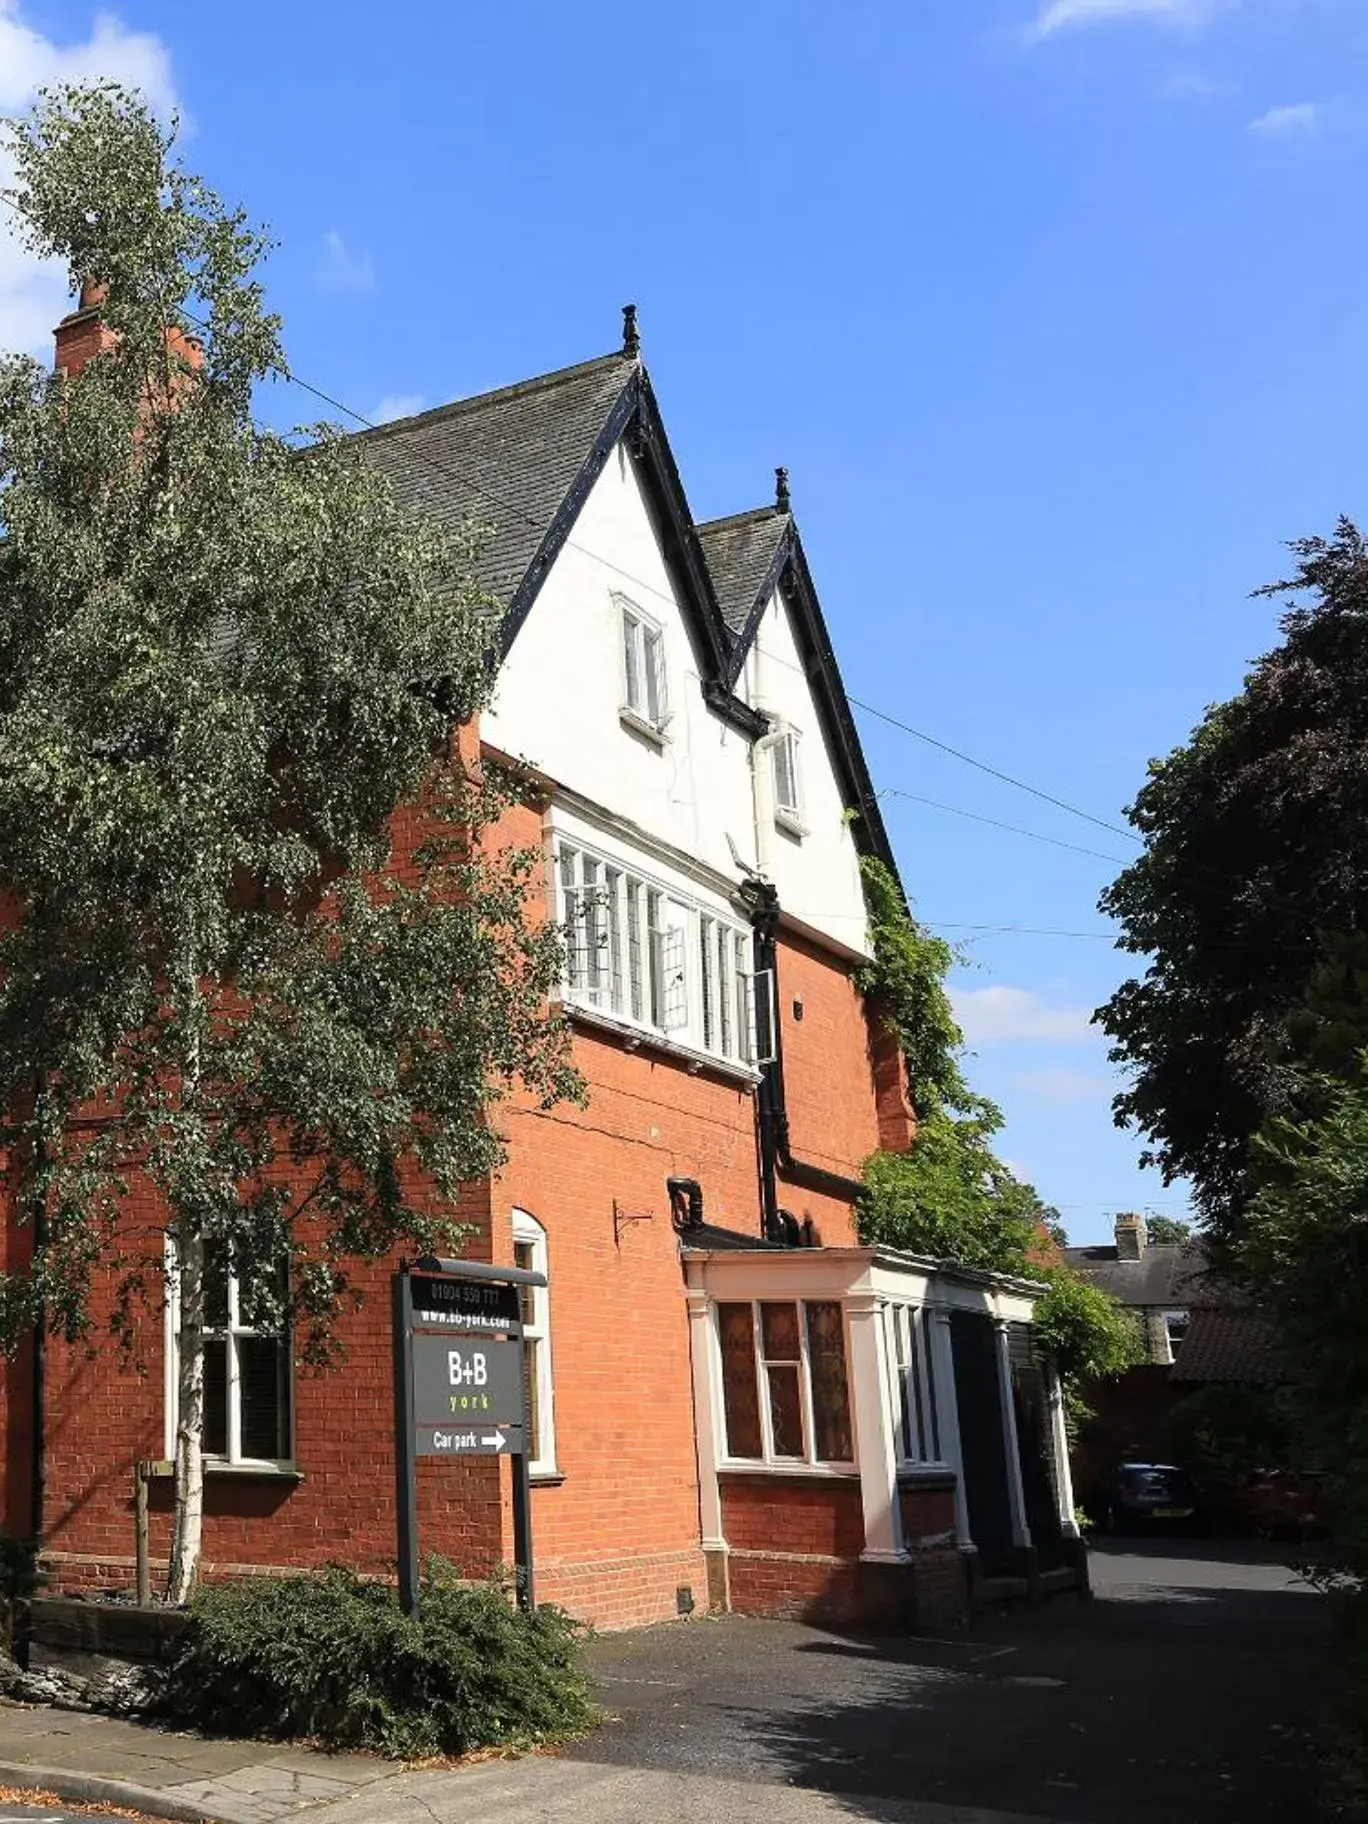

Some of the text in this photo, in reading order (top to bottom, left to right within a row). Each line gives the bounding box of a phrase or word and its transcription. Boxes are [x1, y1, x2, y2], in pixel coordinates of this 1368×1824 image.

[448, 1351, 487, 1385] B+B
[450, 1393, 488, 1412] york
[433, 1431, 477, 1452] Car park
